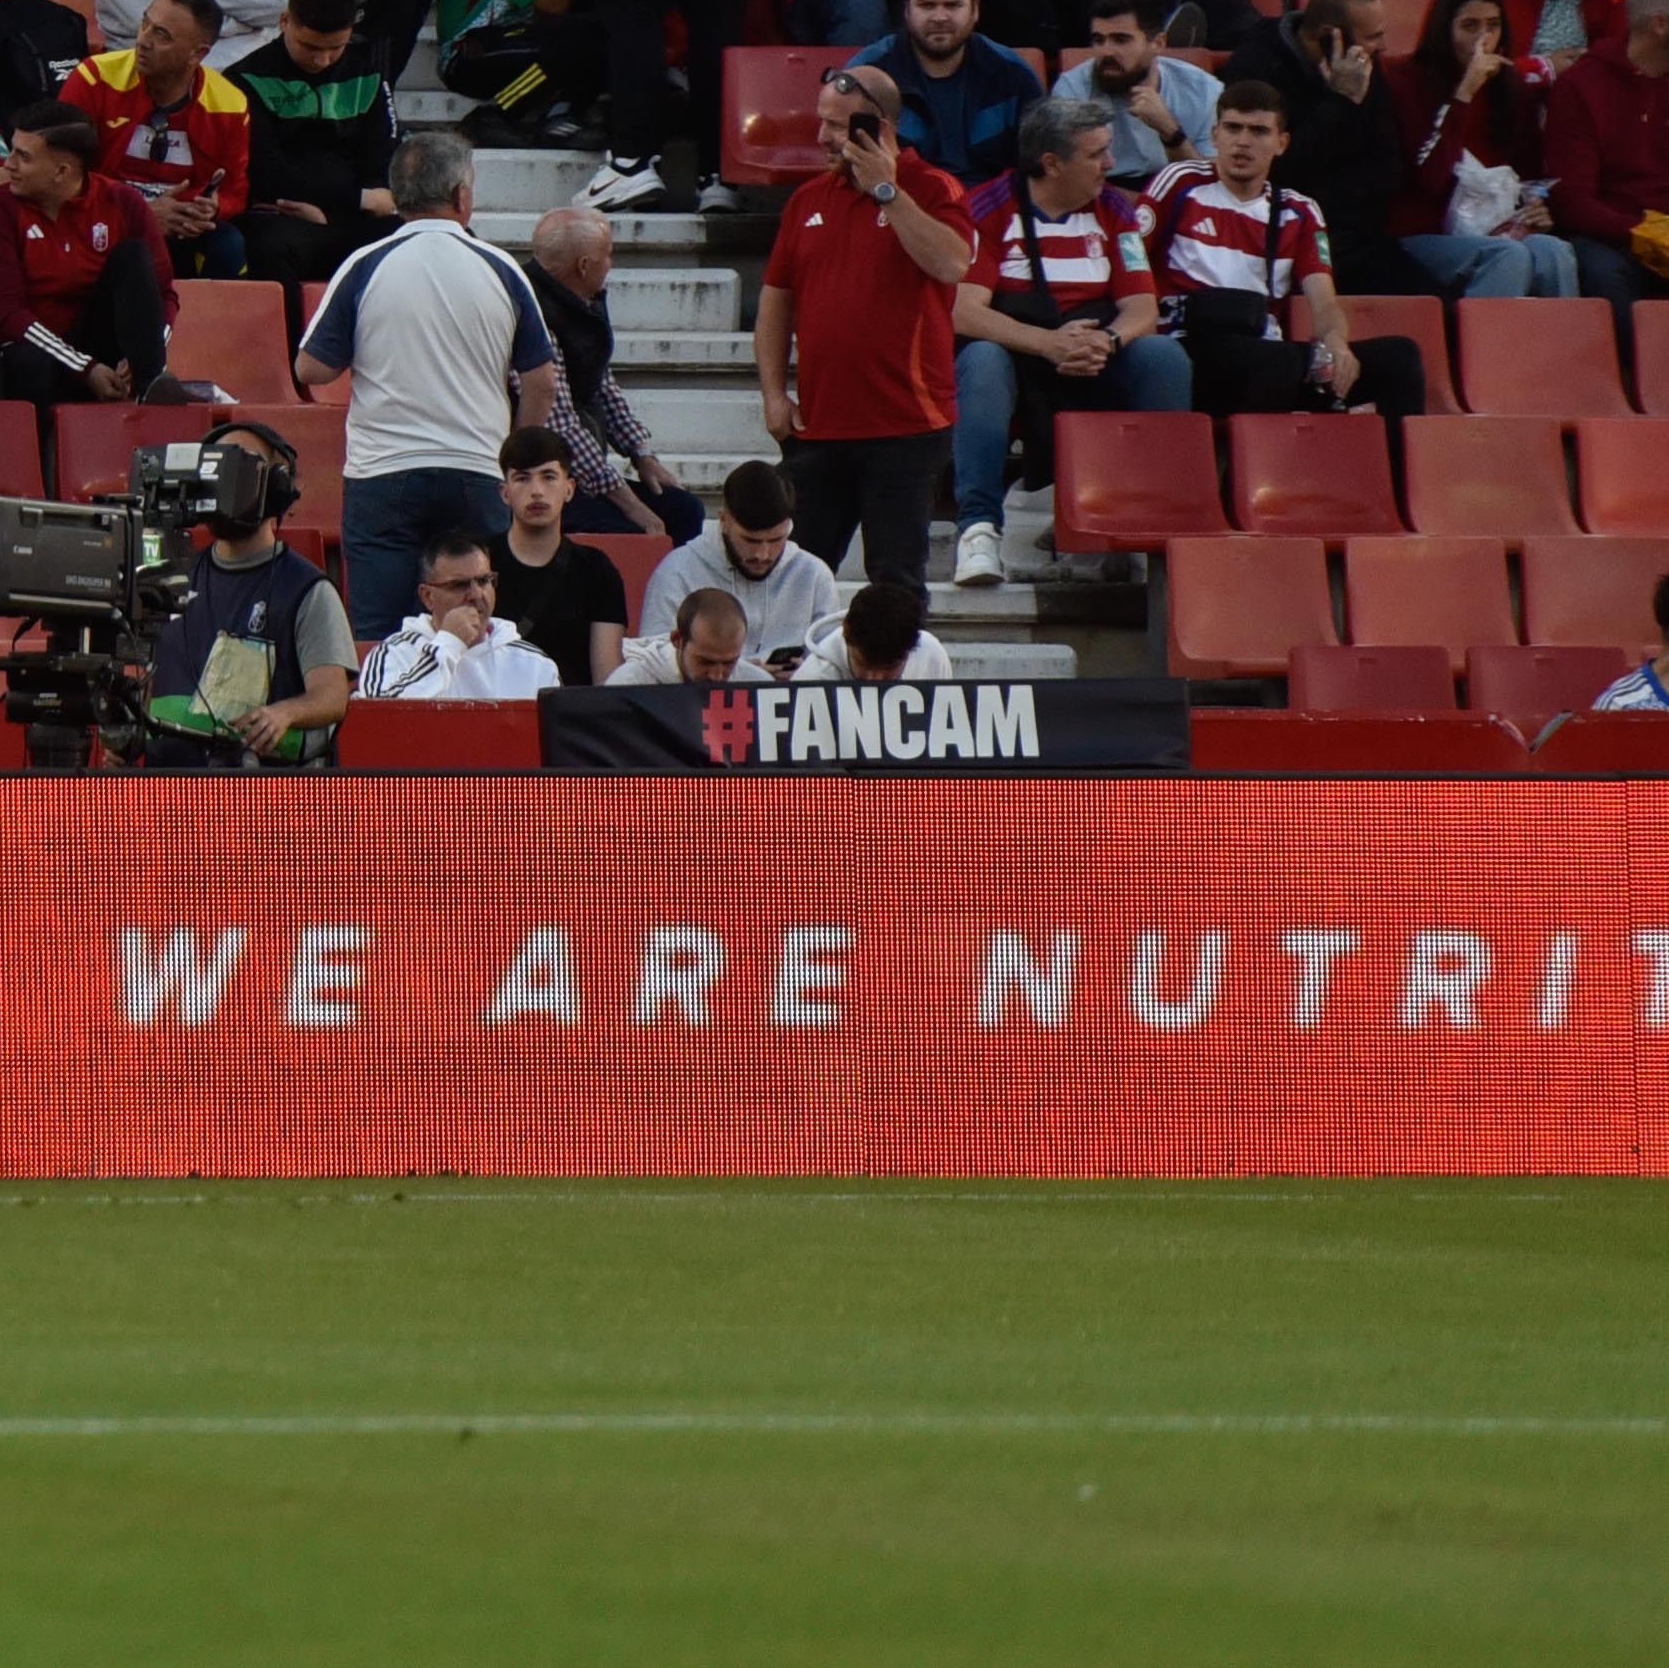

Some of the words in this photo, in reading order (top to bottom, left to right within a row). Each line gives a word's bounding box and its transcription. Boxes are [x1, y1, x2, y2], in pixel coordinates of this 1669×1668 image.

[701, 684, 1039, 763] #FANCAM
[117, 925, 371, 1027] WE
[487, 925, 855, 1027] ARE
